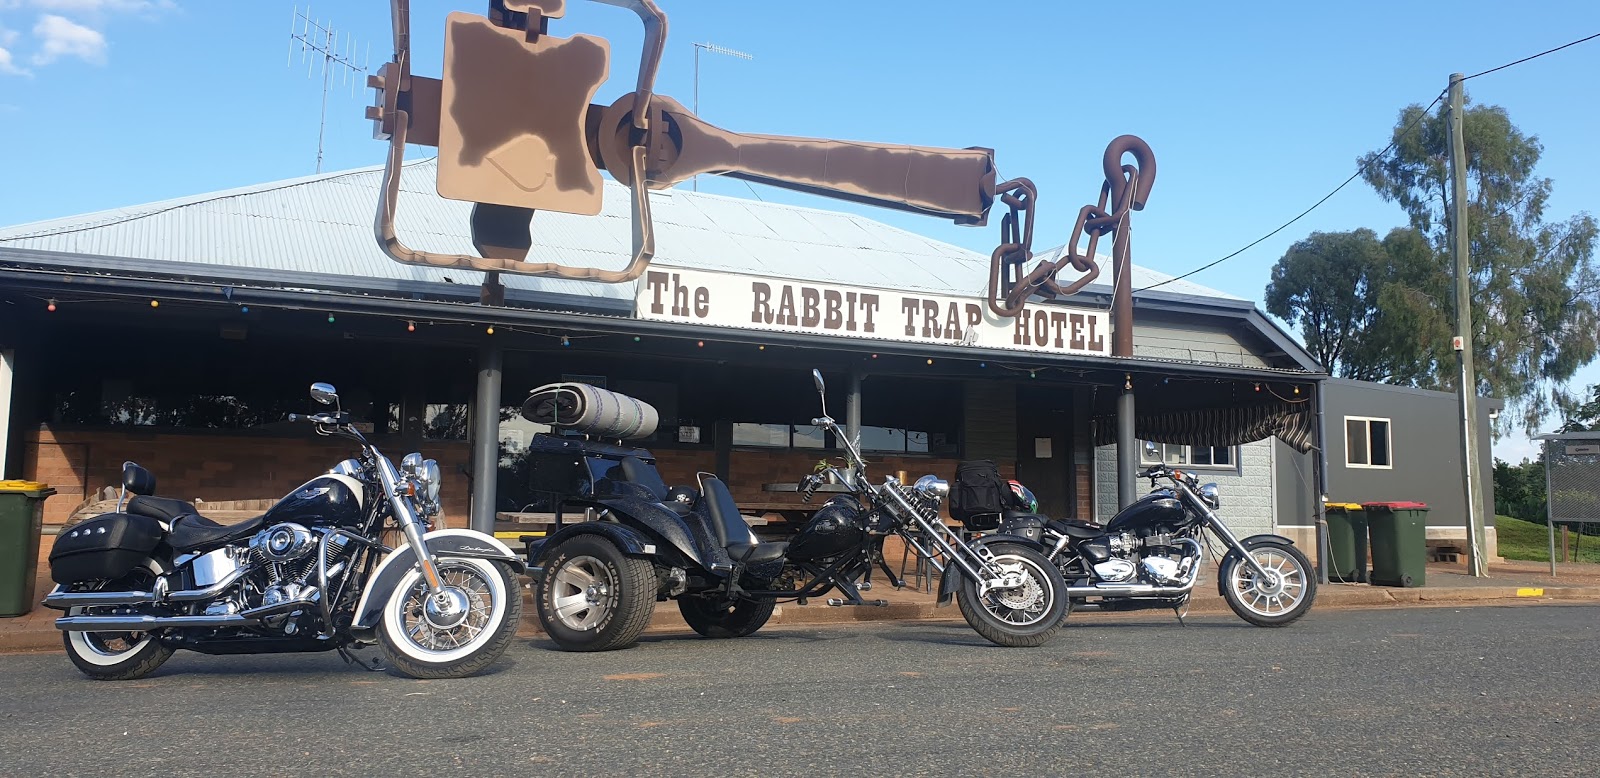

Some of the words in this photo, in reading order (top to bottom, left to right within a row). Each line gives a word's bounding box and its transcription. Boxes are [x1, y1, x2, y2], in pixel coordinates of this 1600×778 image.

[647, 270, 709, 318] The
[751, 281, 879, 333] RABBIT
[901, 297, 982, 341] TRAP
[1013, 309, 1104, 352] HOTEL
[543, 553, 567, 610] HANKOOK
[607, 561, 620, 609] VENTUS
